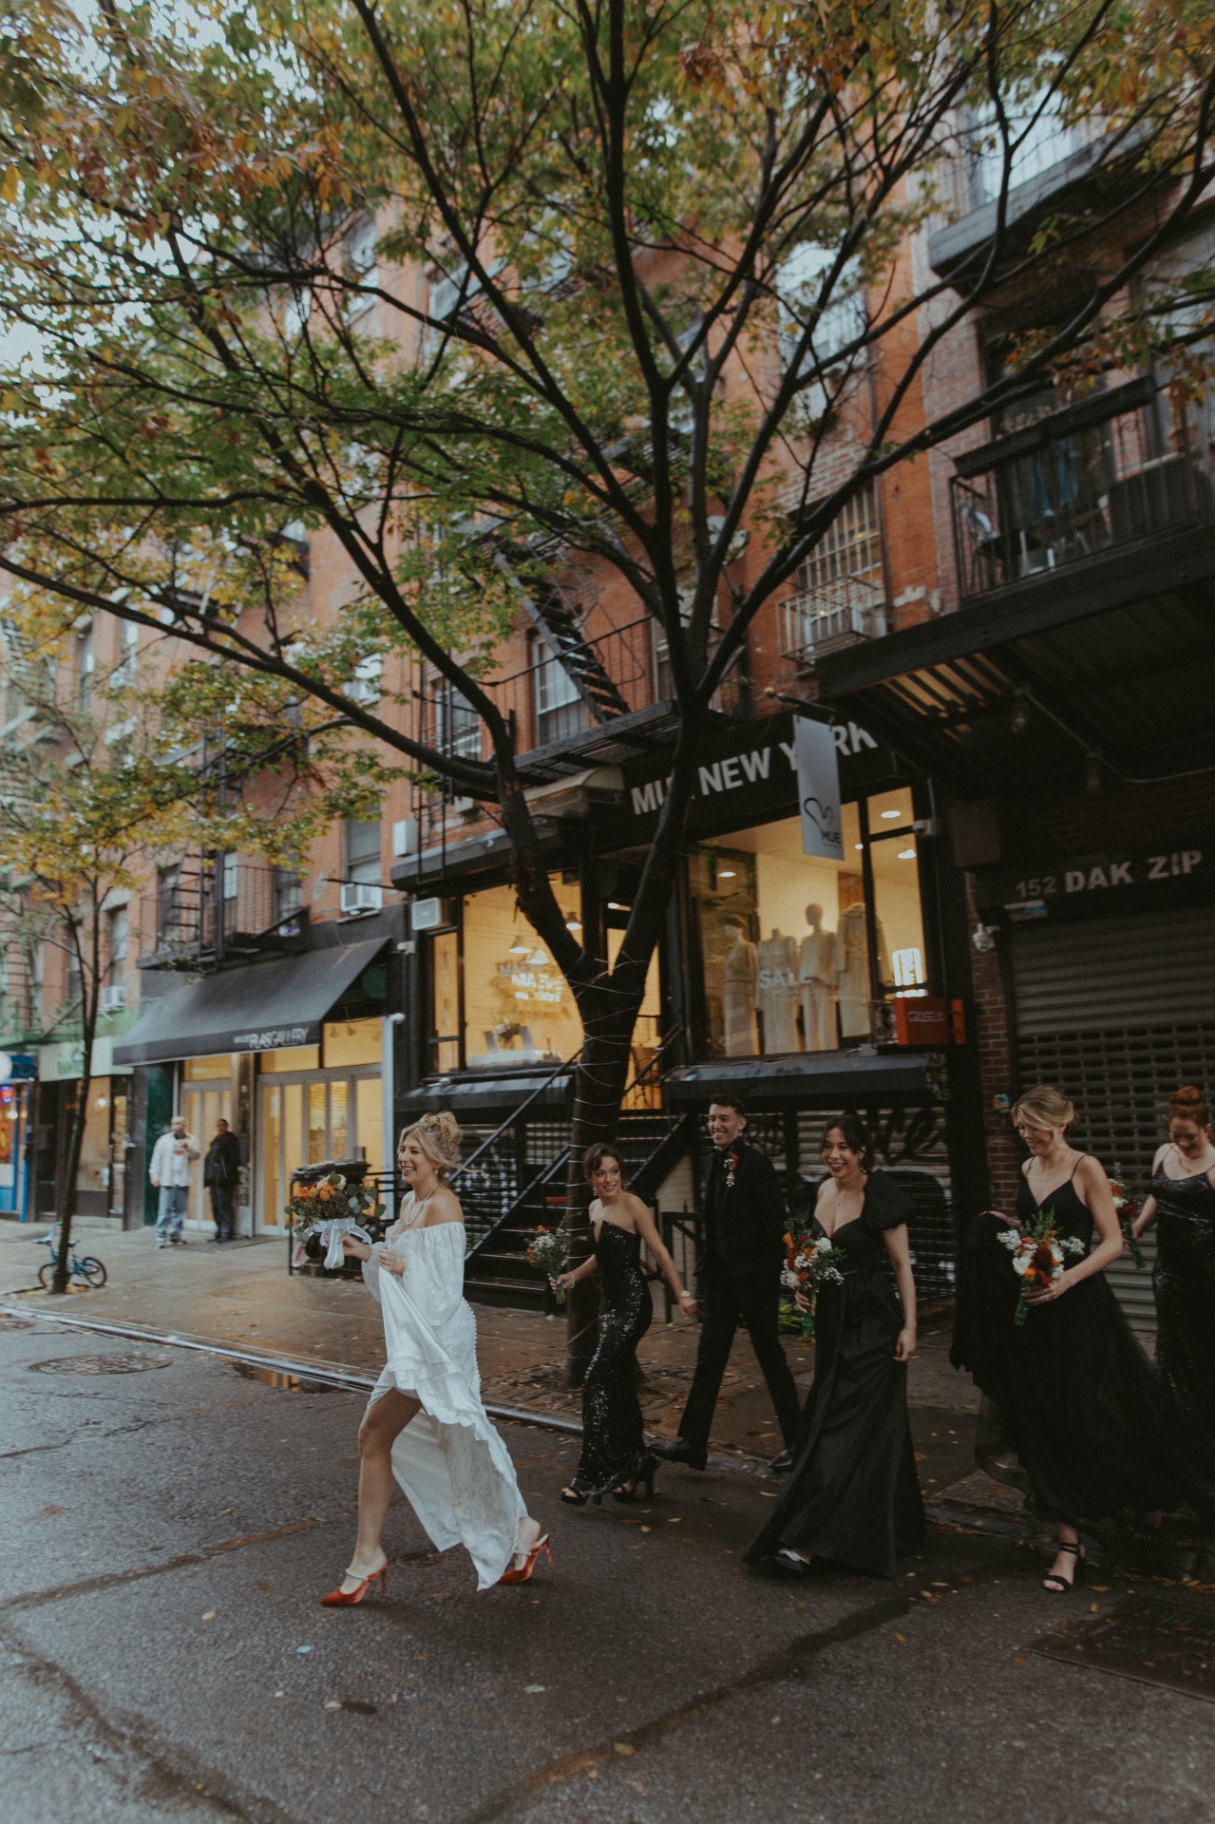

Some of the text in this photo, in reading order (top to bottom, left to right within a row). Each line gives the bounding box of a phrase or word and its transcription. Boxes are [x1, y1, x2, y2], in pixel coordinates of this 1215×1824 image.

[631, 721, 878, 815] MU NEW YRK
[1015, 851, 1202, 898] 152 DAK ZIP
